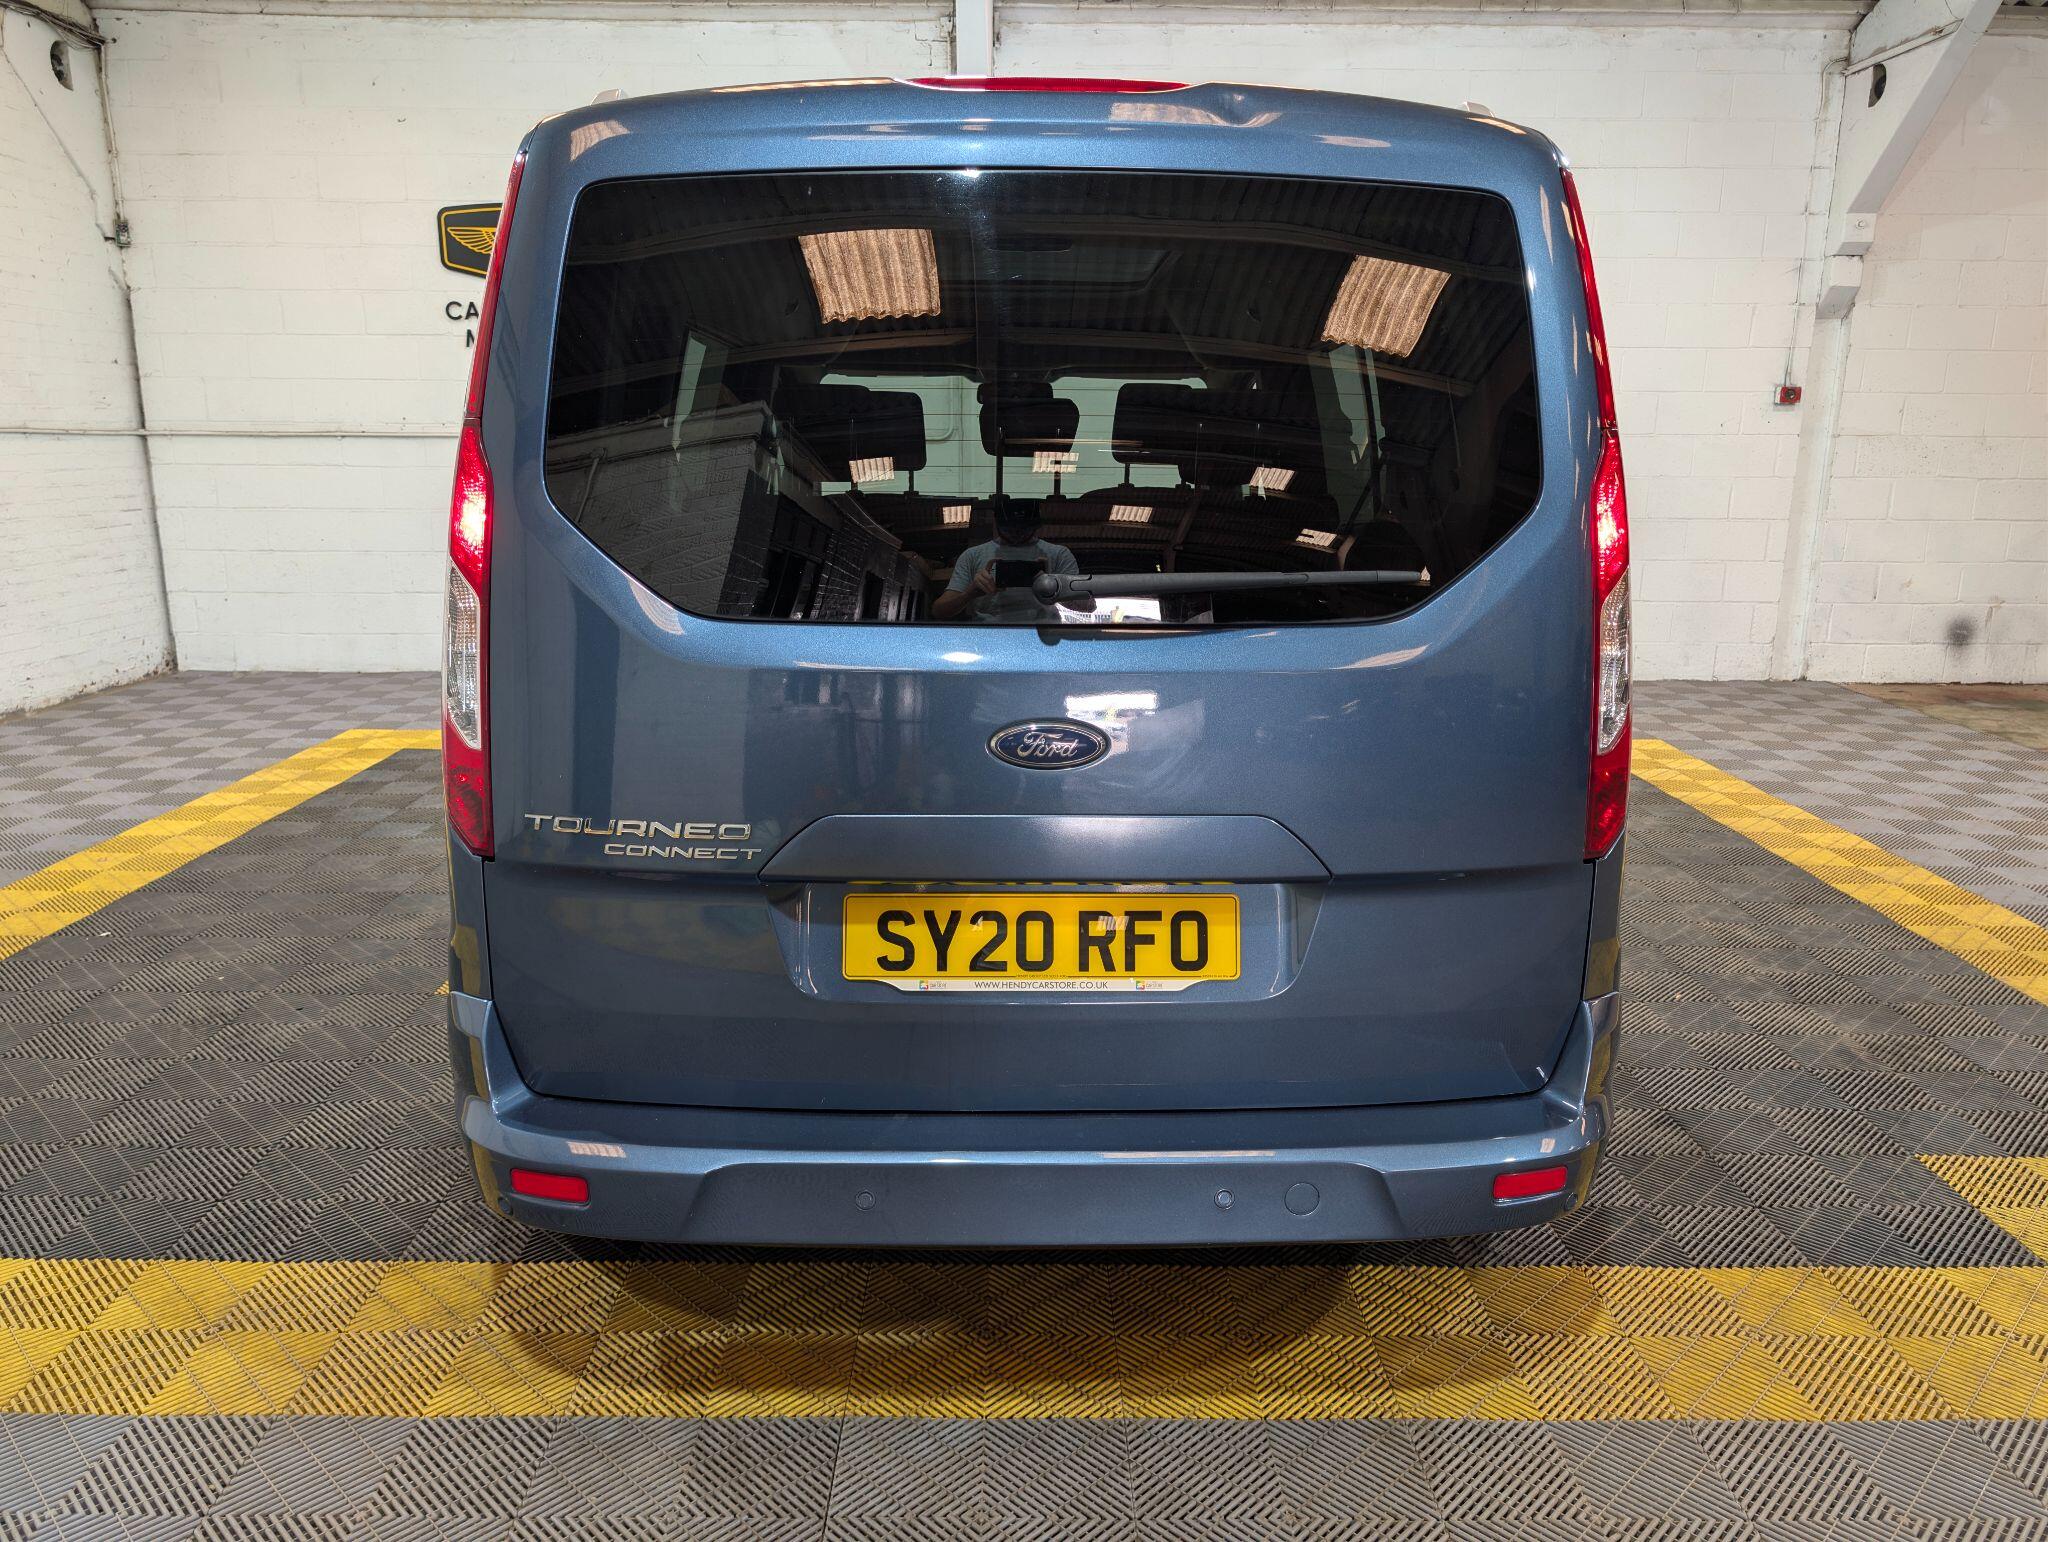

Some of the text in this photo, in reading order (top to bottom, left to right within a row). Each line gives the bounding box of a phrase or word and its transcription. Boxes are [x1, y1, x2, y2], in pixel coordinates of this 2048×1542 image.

[1017, 731, 1078, 757] Ford
[524, 813, 751, 840] TOURNEO
[603, 843, 762, 860] CONNECT
[876, 910, 1208, 972] SY20 RFO
[974, 981, 1109, 989] WWW.HENDYCARSTORE.CO.UK
